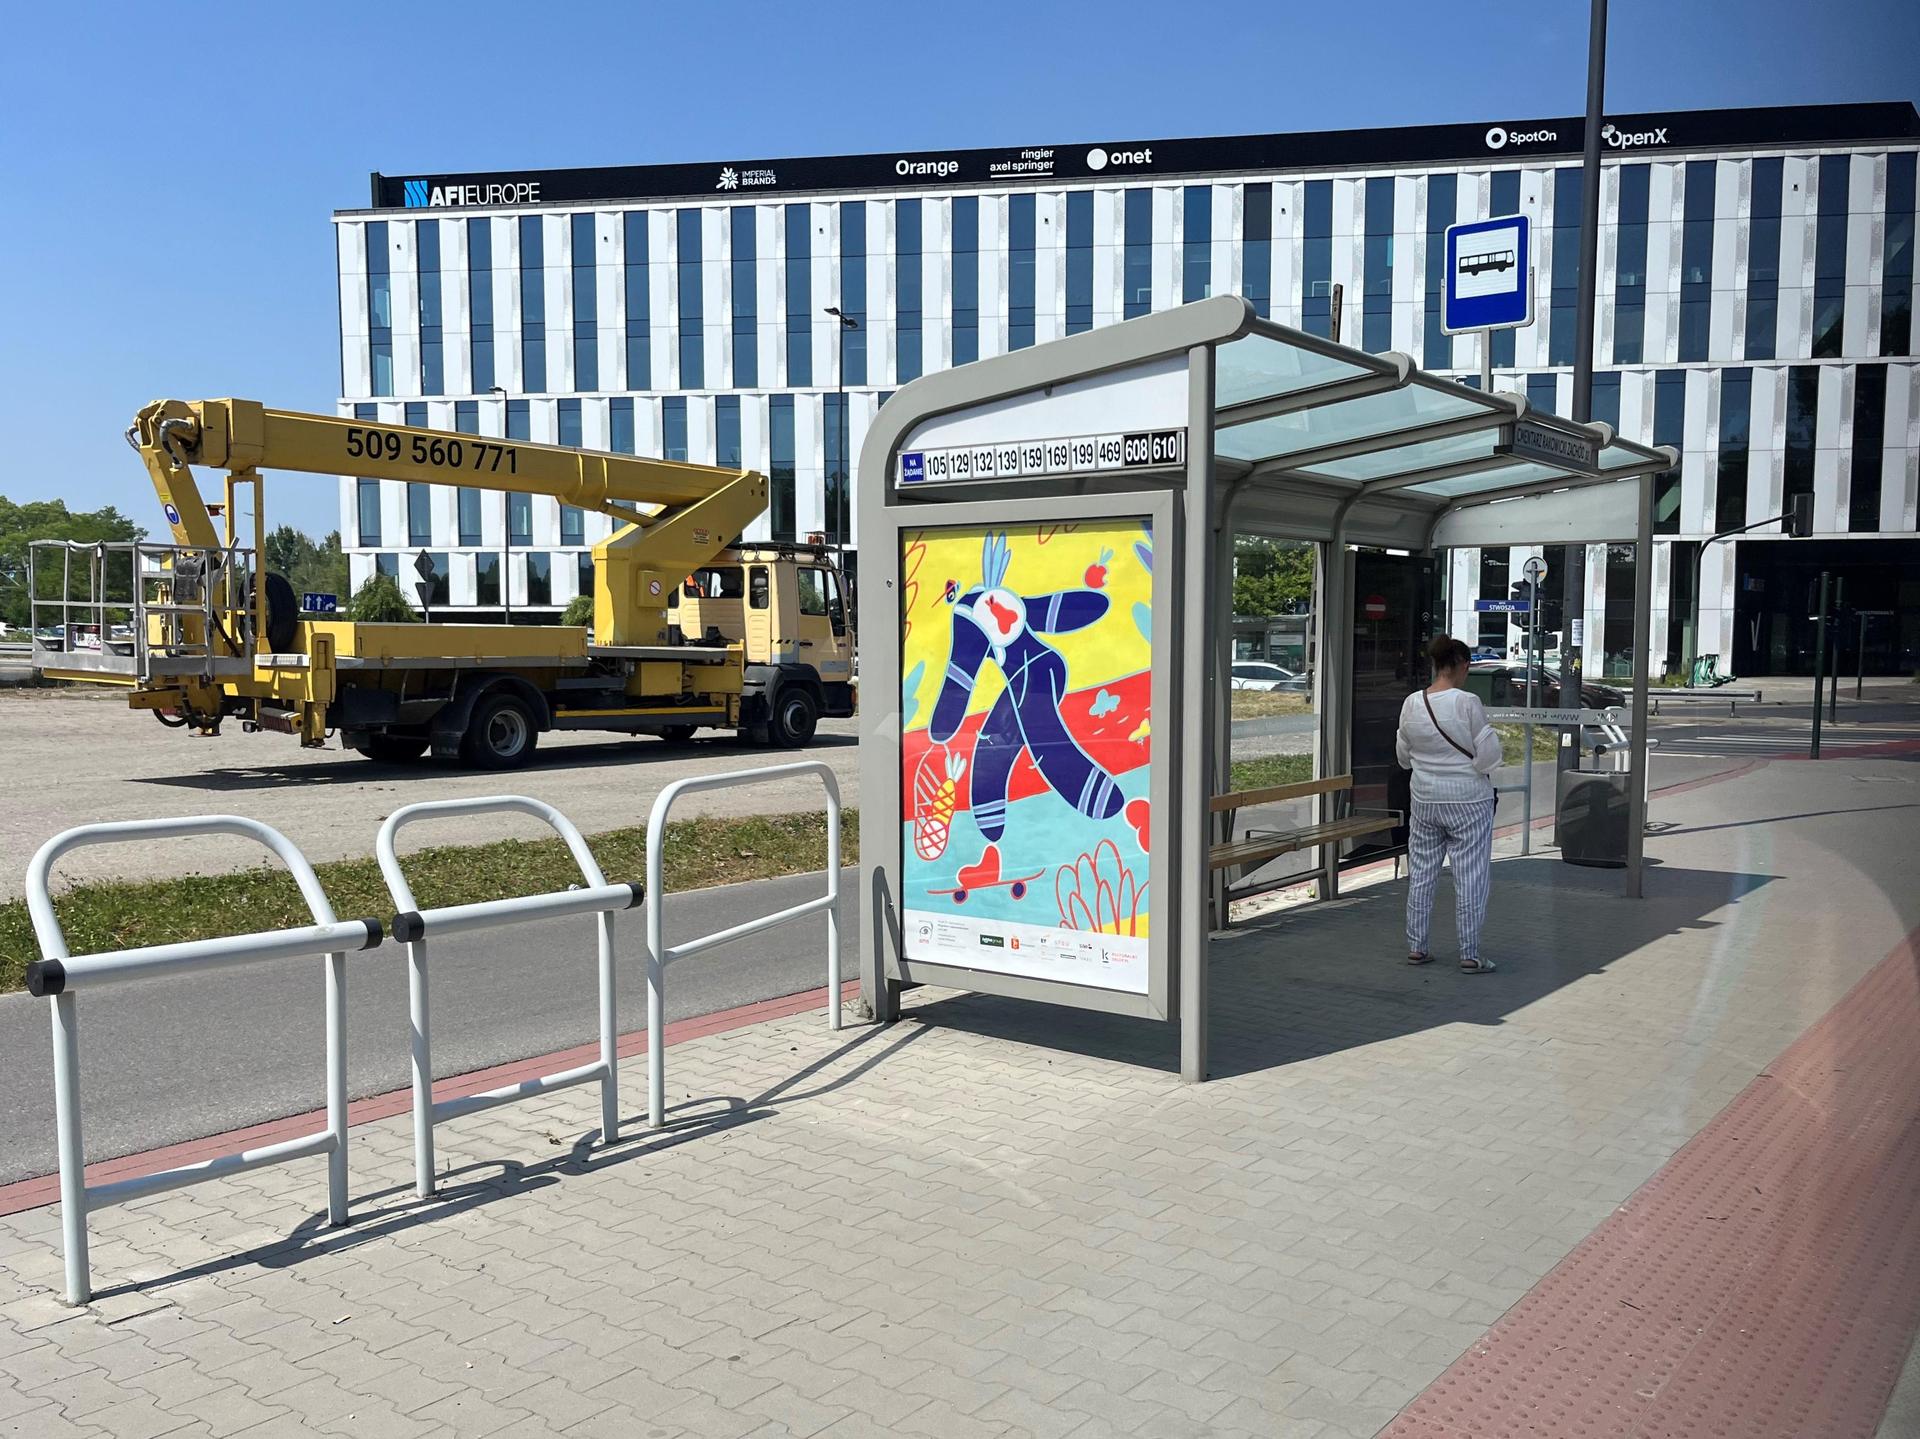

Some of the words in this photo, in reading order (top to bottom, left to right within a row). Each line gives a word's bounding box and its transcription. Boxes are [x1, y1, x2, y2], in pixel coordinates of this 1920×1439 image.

[1510, 129, 1557, 146] SpotOn
[1608, 127, 1668, 149] OpenX
[1021, 149, 1054, 161] ringier
[1111, 148, 1153, 165] onet
[742, 170, 776, 179] IMPERIAL
[895, 159, 959, 177] Orange
[989, 161, 1011, 172] axel
[1012, 159, 1054, 173] springer
[742, 177, 777, 186] BRANDS
[346, 427, 402, 461] 509
[411, 435, 463, 469] 560
[470, 441, 517, 475] 771
[927, 455, 947, 476] 105
[950, 453, 970, 473] 129
[973, 452, 993, 472] 132
[998, 451, 1017, 471] 139
[1022, 448, 1042, 469] 159
[1047, 446, 1068, 467] 169
[1072, 443, 1094, 465] 199
[1099, 440, 1121, 463] 469
[1125, 437, 1148, 462] 608
[1152, 435, 1176, 459] 610
